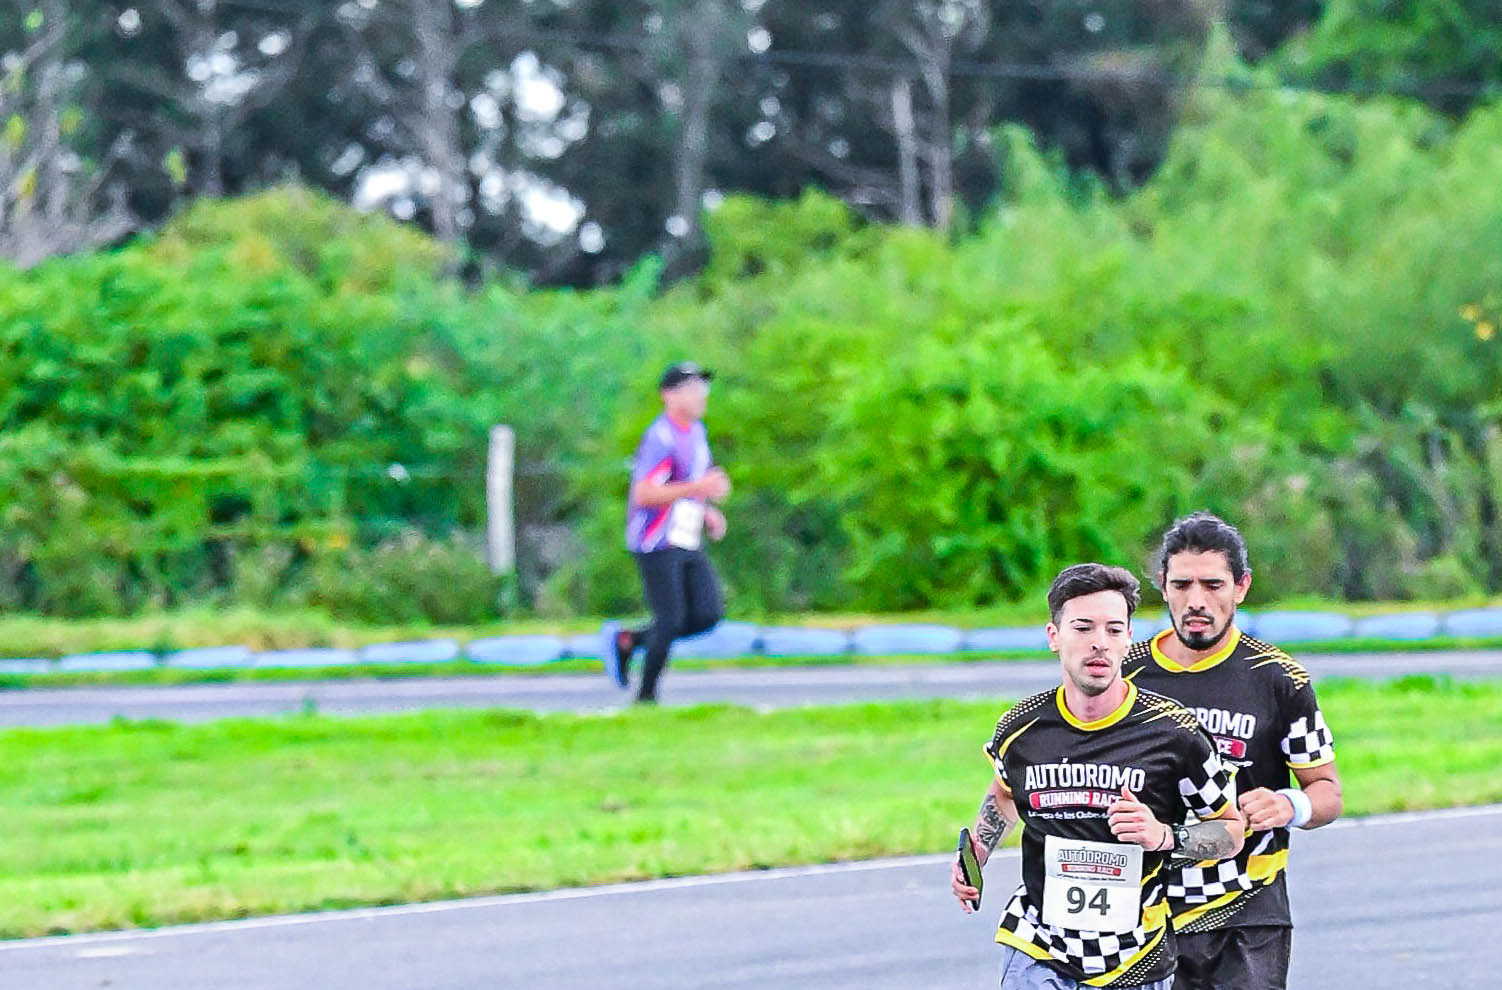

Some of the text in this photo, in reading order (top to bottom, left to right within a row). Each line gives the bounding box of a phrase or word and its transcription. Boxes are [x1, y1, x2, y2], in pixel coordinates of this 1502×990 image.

[1024, 757, 1146, 793] AUTÓDROMO
[1039, 791, 1090, 808] RUNNING
[1057, 846, 1128, 867] AUTÓDROMO
[1066, 886, 1111, 916] 94
